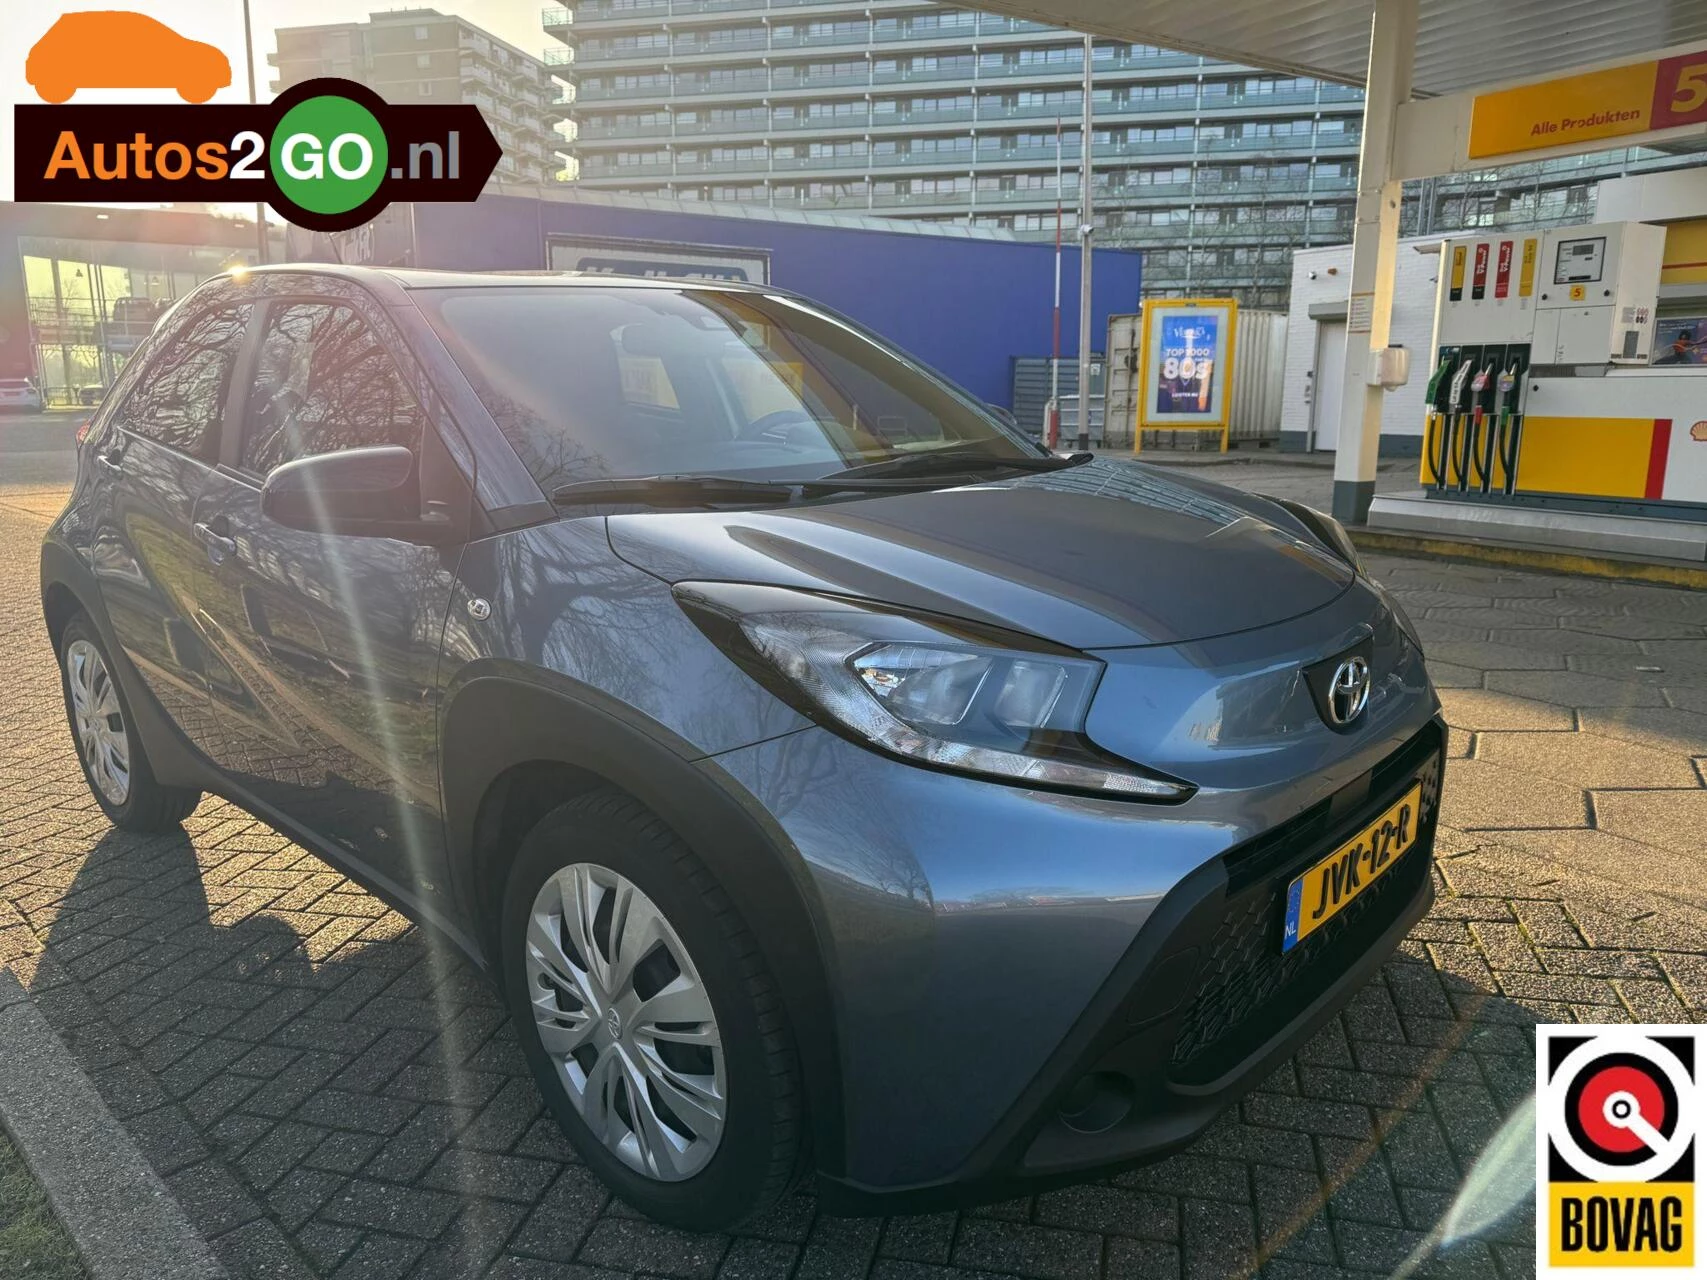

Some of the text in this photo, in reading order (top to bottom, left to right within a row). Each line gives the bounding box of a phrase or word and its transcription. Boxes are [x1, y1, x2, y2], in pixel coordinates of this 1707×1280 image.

[1531, 109, 1640, 137] Alle Produkten
[1574, 288, 1582, 298] 5
[1166, 348, 1184, 357] TOP
[1312, 803, 1411, 920] JVK-12-R
[1284, 921, 1297, 939] NL
